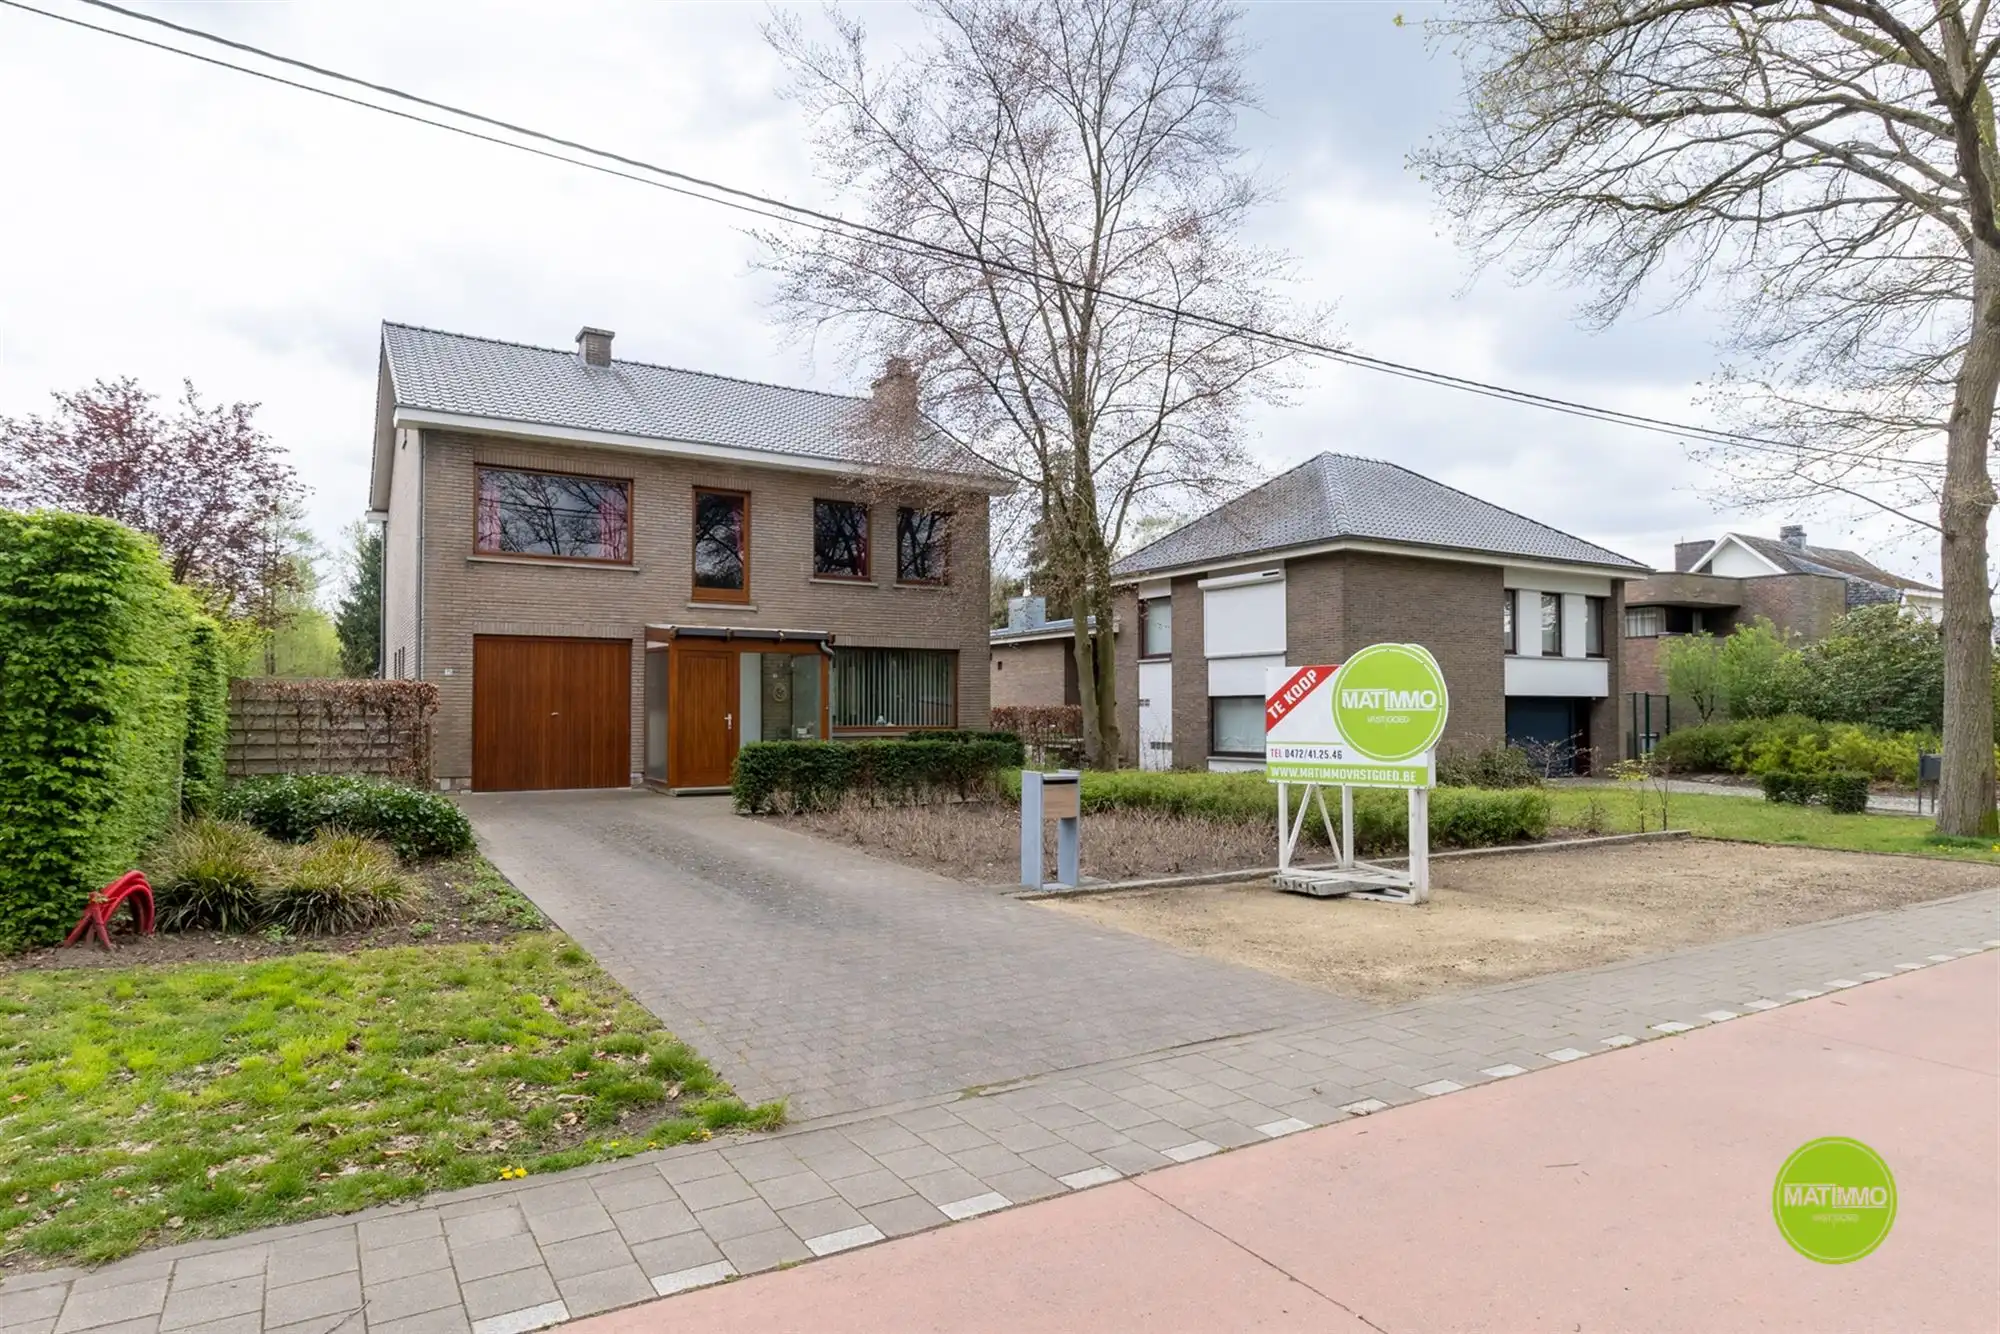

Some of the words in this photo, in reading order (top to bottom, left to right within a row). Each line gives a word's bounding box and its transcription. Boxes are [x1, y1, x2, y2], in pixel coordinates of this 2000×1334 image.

[1267, 700, 1286, 719] TE
[1283, 669, 1317, 705] KOOP
[1342, 689, 1437, 710] MATIMMO
[1270, 748, 1282, 758] TEL
[1284, 748, 1343, 760] 0472/41.25.46
[1270, 766, 1417, 783] WWW.MATIMMOVASTGOED.BE
